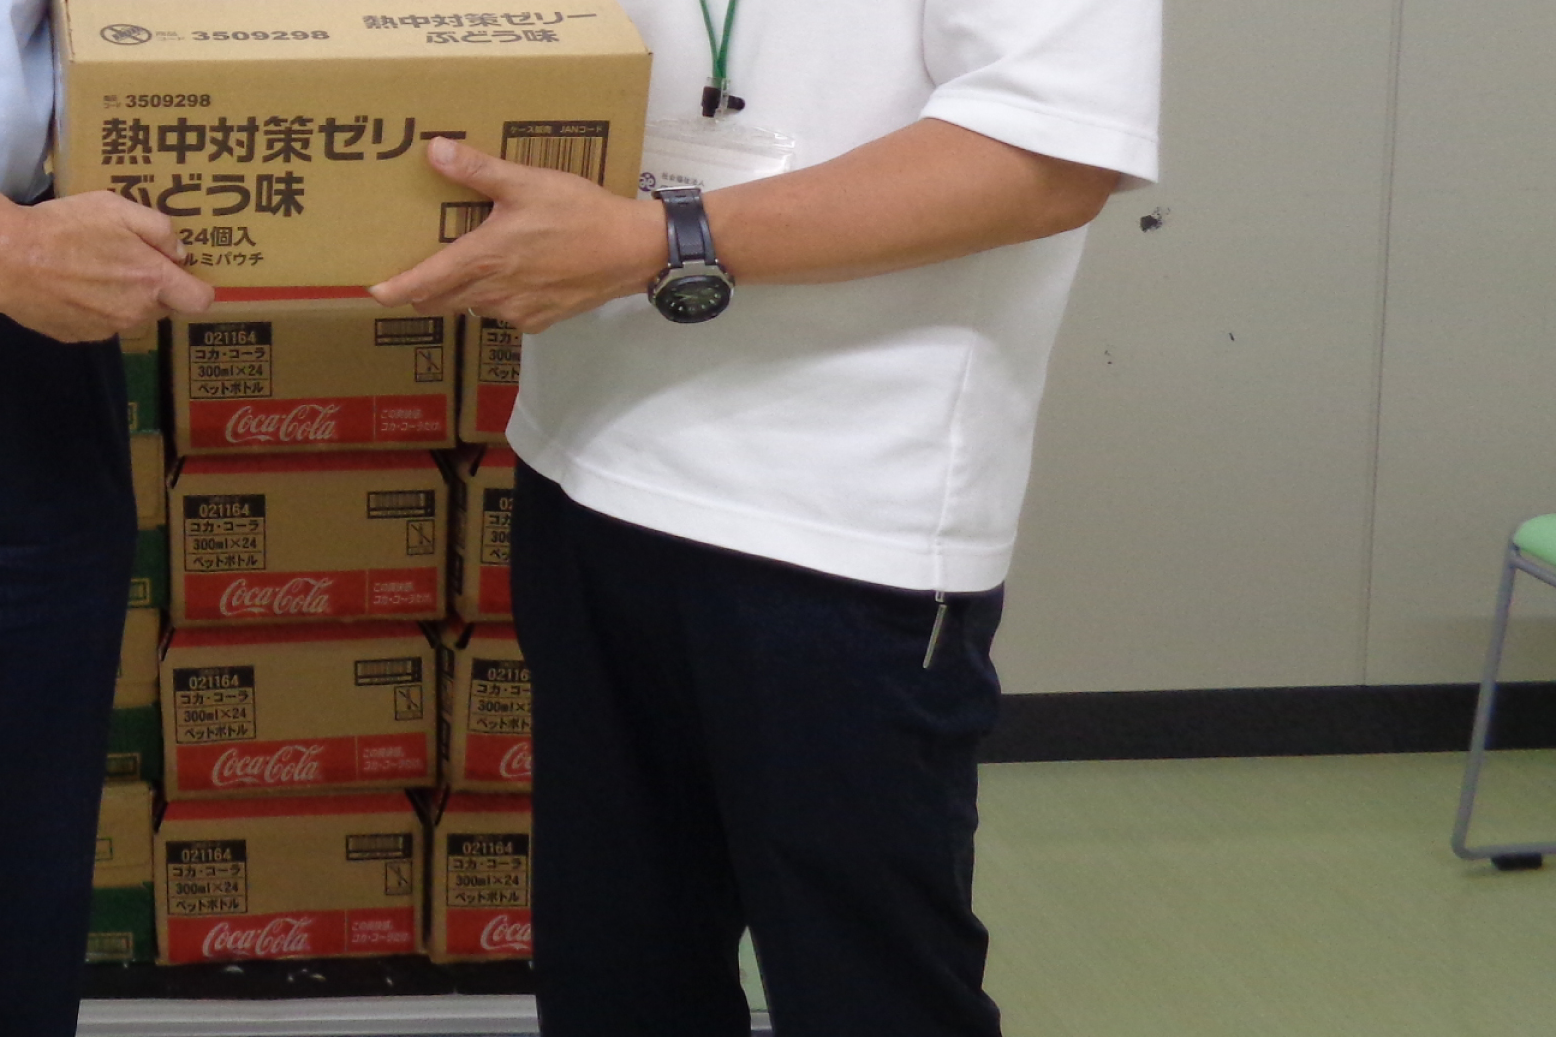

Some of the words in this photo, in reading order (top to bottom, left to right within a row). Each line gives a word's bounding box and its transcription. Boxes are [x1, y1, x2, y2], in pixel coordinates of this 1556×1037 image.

[362, 11, 597, 30] 熱中対策ゼリー
[191, 30, 331, 42] 3509298
[425, 30, 560, 44] ぶどう味
[125, 94, 211, 108] 3509298
[101, 116, 466, 165] 熱中対策ゼリー
[109, 171, 305, 219] ぶどう味
[179, 226, 257, 247] 24個入
[183, 251, 264, 266] ルミパウチ
[204, 330, 257, 345] 021164
[487, 331, 519, 343] コカ・
[194, 348, 266, 361] コカ・コーラ
[197, 364, 263, 378] 300ml×24
[488, 367, 520, 380] ペット
[197, 382, 264, 395] ペットボトル
[225, 404, 340, 443] Coca-Cola
[199, 502, 250, 517] 021164
[189, 520, 260, 533] コカ・コーラ
[191, 536, 257, 551] 300ml×24
[192, 554, 258, 568] ペットボトル
[219, 577, 335, 615] Coca-Cola
[188, 675, 239, 689] 021164
[487, 668, 530, 682] 02116
[475, 683, 531, 696] コカ・コー
[179, 691, 250, 705] コカ・コーラ
[183, 706, 247, 722] 300ml×24
[476, 716, 531, 730] ペットボト
[183, 725, 249, 739] ペットボトル
[211, 745, 325, 786] Coca-Cola
[462, 840, 513, 855] 021164
[180, 848, 232, 863] 021164
[452, 857, 522, 871] コカ・コーラ
[171, 865, 241, 878] コカ・コーラ
[174, 880, 239, 895] 300ml×24
[454, 874, 519, 887] 300ml×24
[454, 891, 519, 904] ペットボトル
[175, 898, 240, 912] ペットボトル
[202, 916, 317, 958] Coca-Cola
